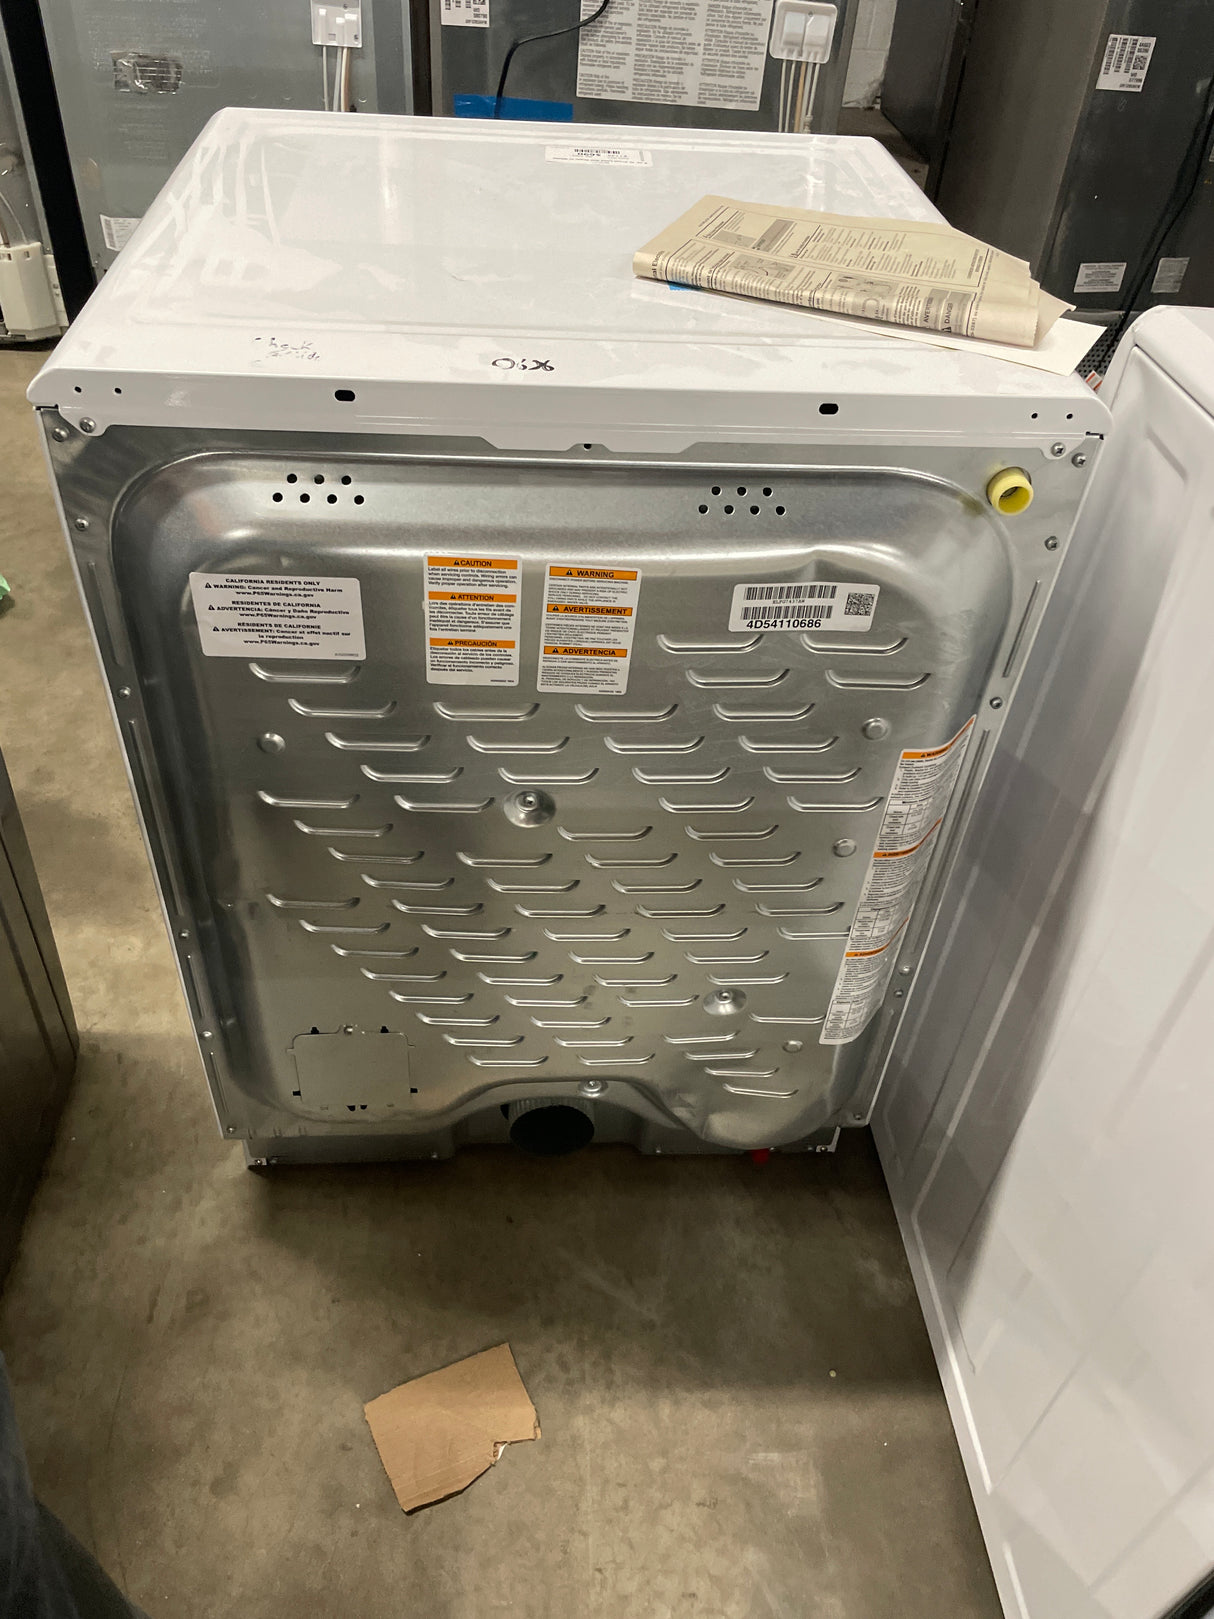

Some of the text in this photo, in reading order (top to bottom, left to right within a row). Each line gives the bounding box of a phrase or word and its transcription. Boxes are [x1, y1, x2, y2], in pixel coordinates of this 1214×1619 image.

[460, 559, 492, 567] CAUTION
[576, 570, 615, 578] WARNING
[563, 606, 627, 615] AVERTISSEMENT
[746, 619, 822, 628] 4D54110686
[563, 648, 616, 656] ADVERTENCIA
